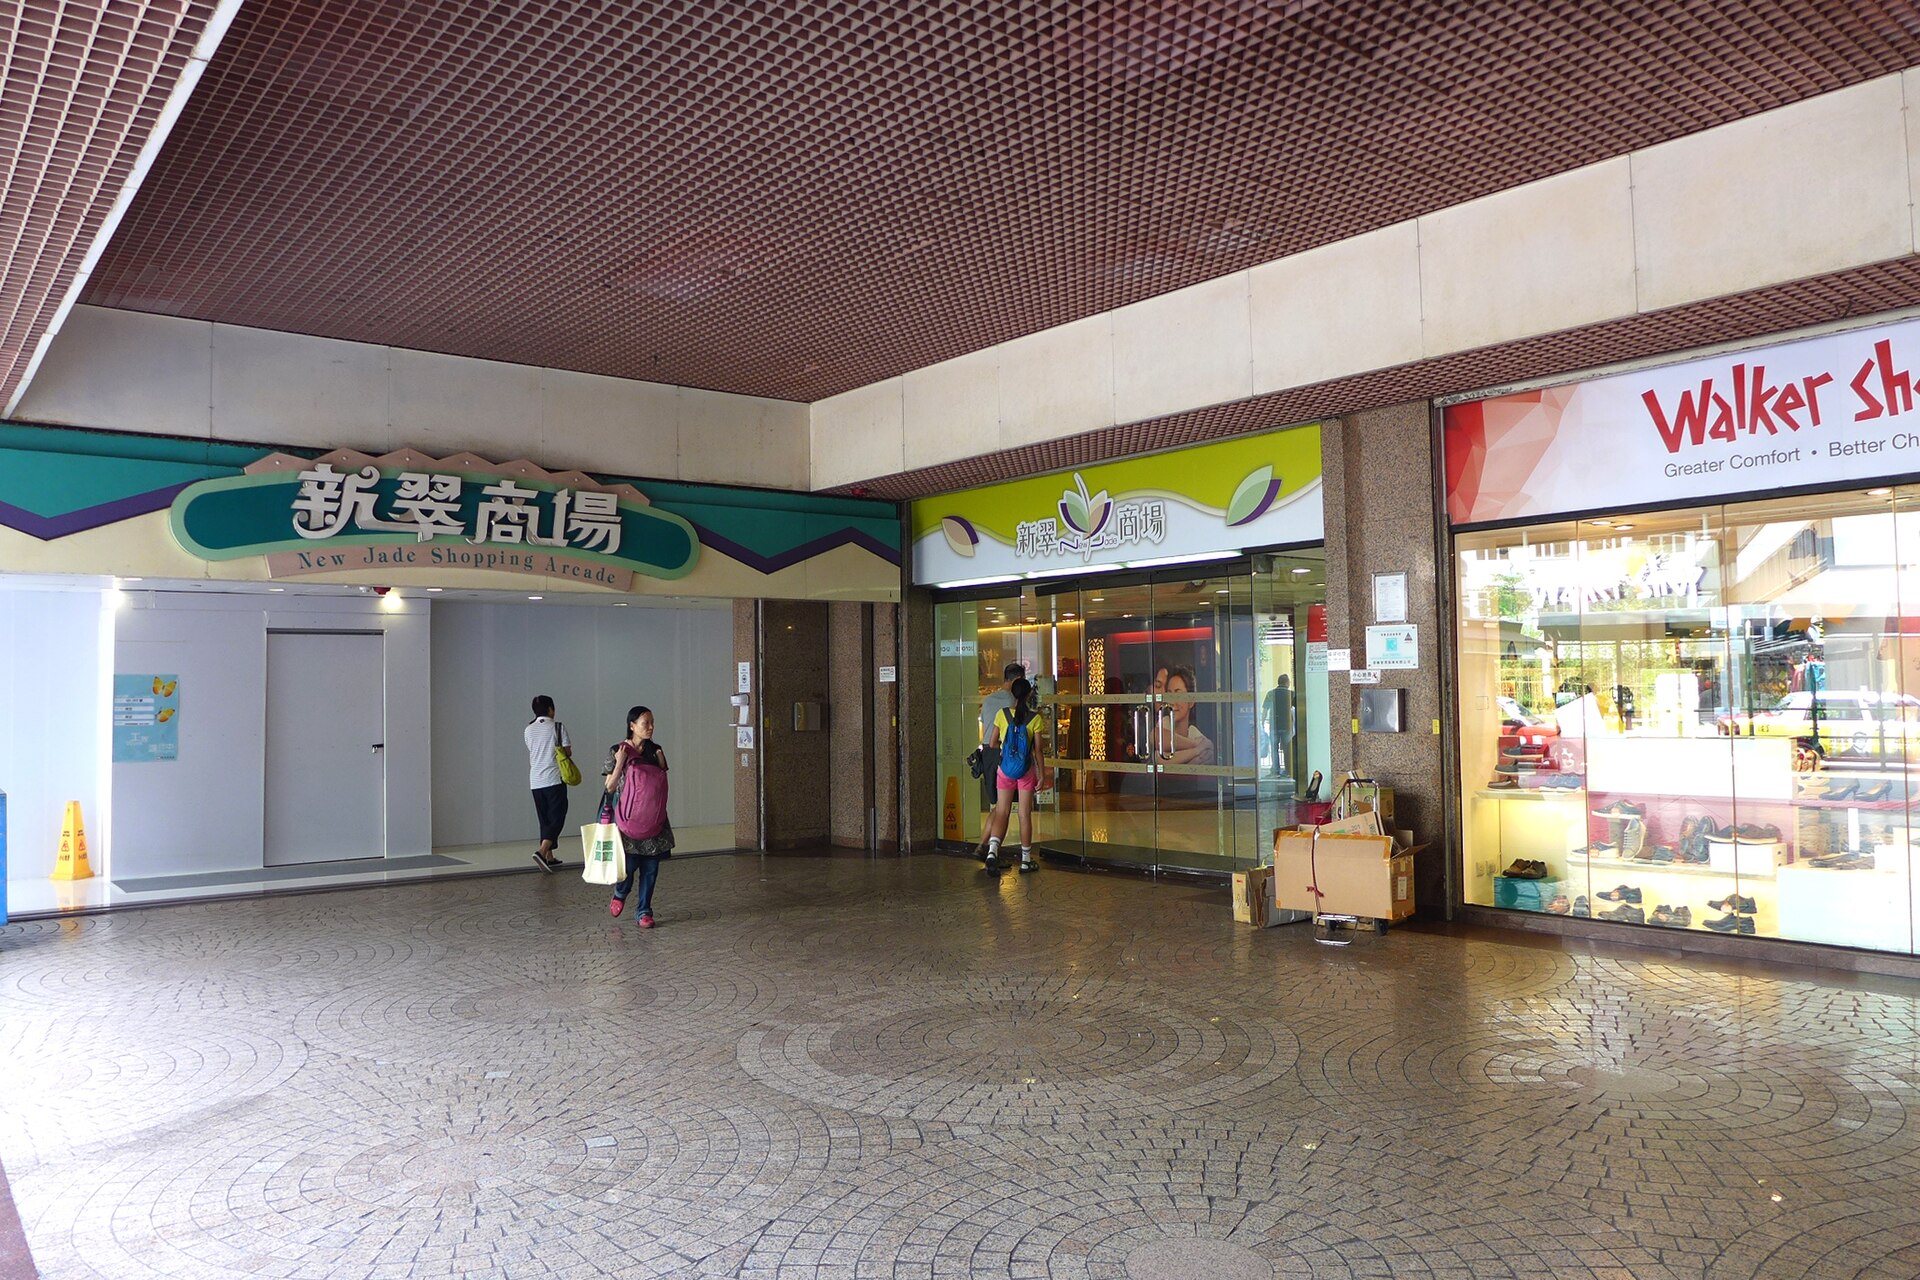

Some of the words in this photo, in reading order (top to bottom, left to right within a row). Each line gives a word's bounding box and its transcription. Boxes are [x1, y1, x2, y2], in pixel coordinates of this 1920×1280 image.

[1641, 363, 1834, 454] Walker
[1849, 338, 1920, 422] Sh
[1664, 458, 1725, 478] Greater
[1729, 447, 1801, 470] Comfort
[1829, 438, 1886, 457] Better
[291, 463, 623, 554] 新翠商場
[299, 551, 347, 570] New
[363, 546, 417, 565] Jade
[431, 547, 534, 571] Shopping
[545, 556, 617, 584] Arcade
